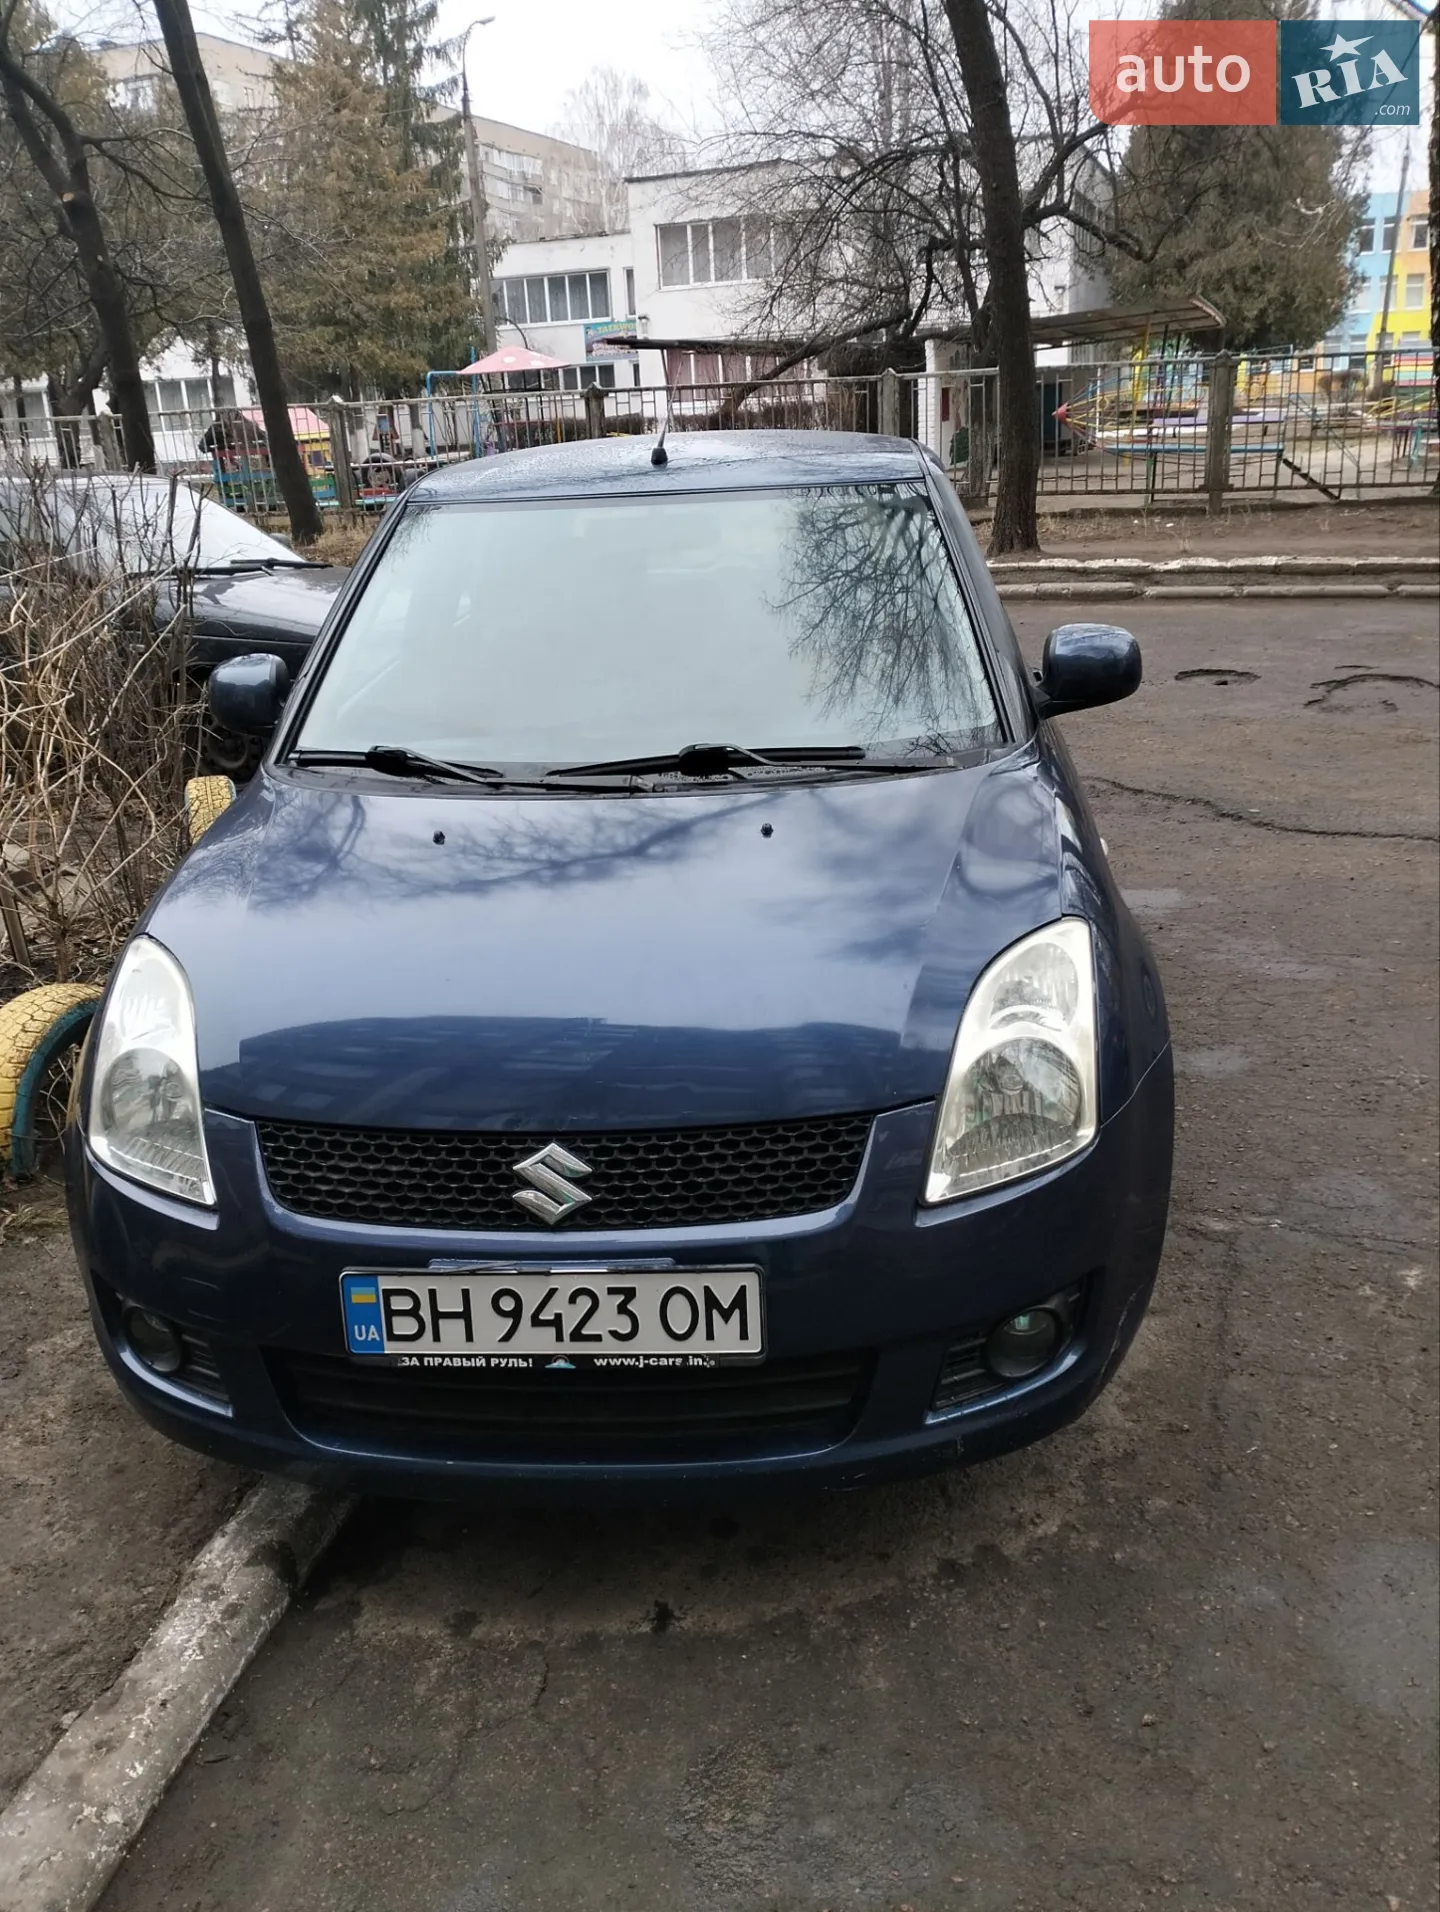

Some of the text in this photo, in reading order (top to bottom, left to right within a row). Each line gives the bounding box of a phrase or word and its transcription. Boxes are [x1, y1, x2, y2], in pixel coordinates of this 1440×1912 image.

[381, 1284, 750, 1343] BH 9423 OM
[354, 1325, 380, 1341] UA
[401, 1356, 533, 1368] ЗА ПРАВЫЙ РУЛЬ!
